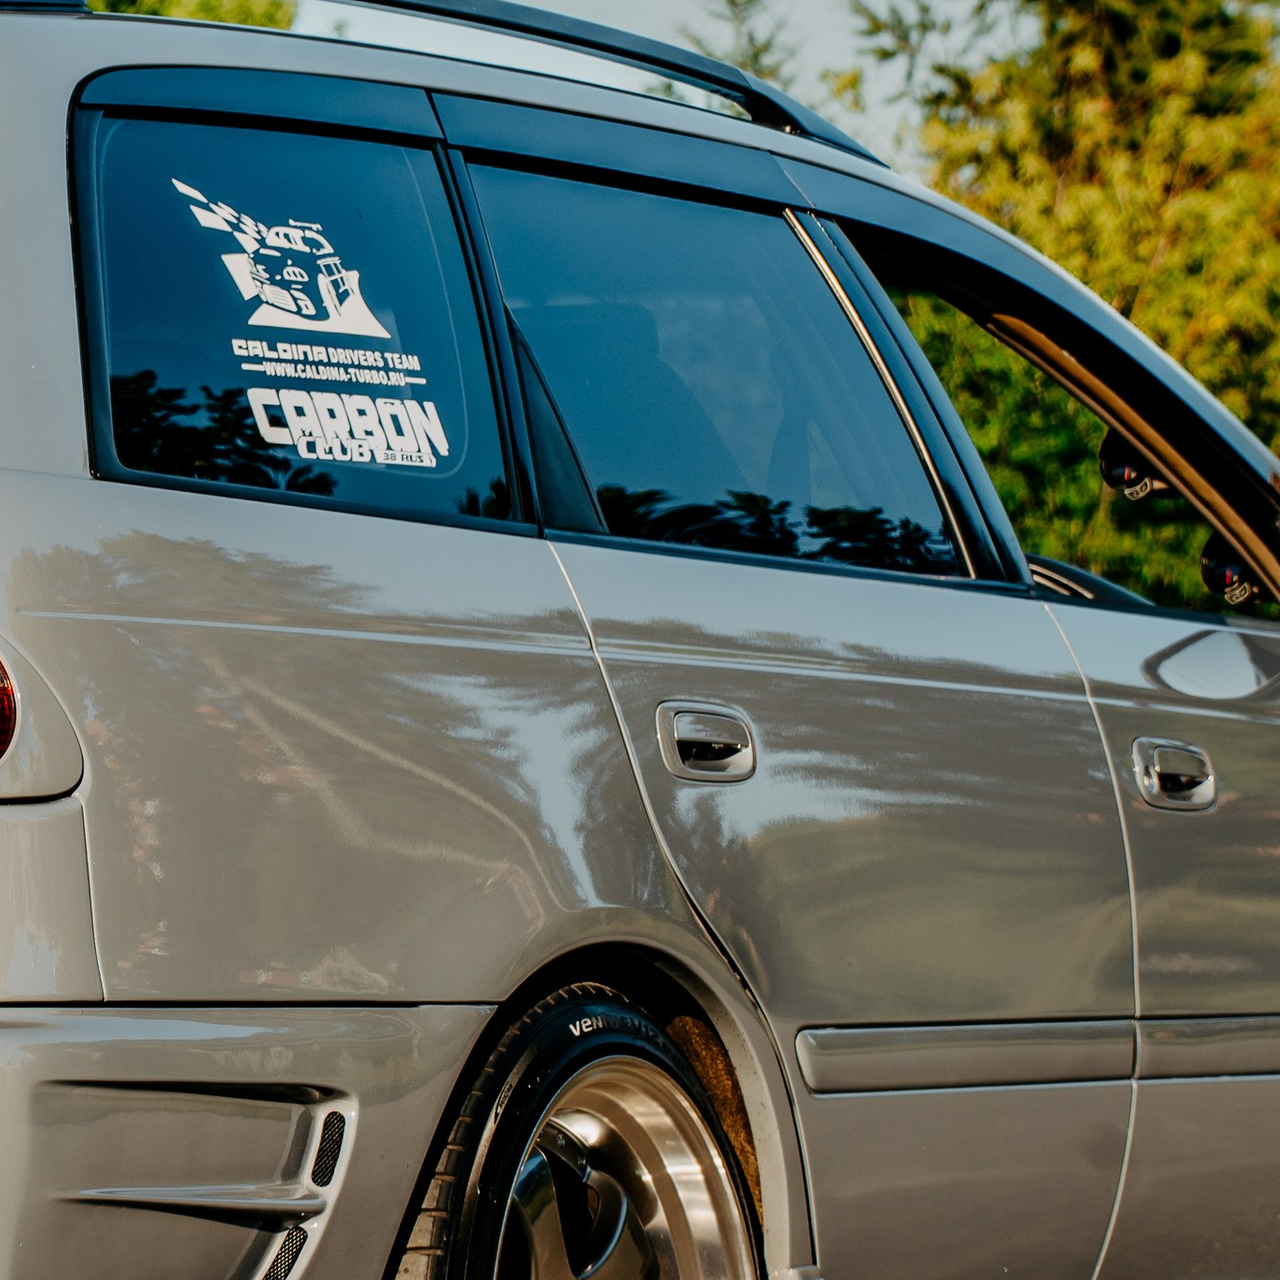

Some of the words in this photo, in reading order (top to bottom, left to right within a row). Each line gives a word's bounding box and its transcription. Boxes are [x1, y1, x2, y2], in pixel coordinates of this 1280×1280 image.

[231, 338, 328, 361] CALDINA
[328, 348, 386, 368] DRIVERS
[386, 354, 421, 371] TEAM
[263, 361, 406, 386] WWW.CALDINA-TURBO.RU
[246, 387, 449, 457] CARBON
[297, 436, 372, 463] CLUB
[382, 452, 398, 462] 38
